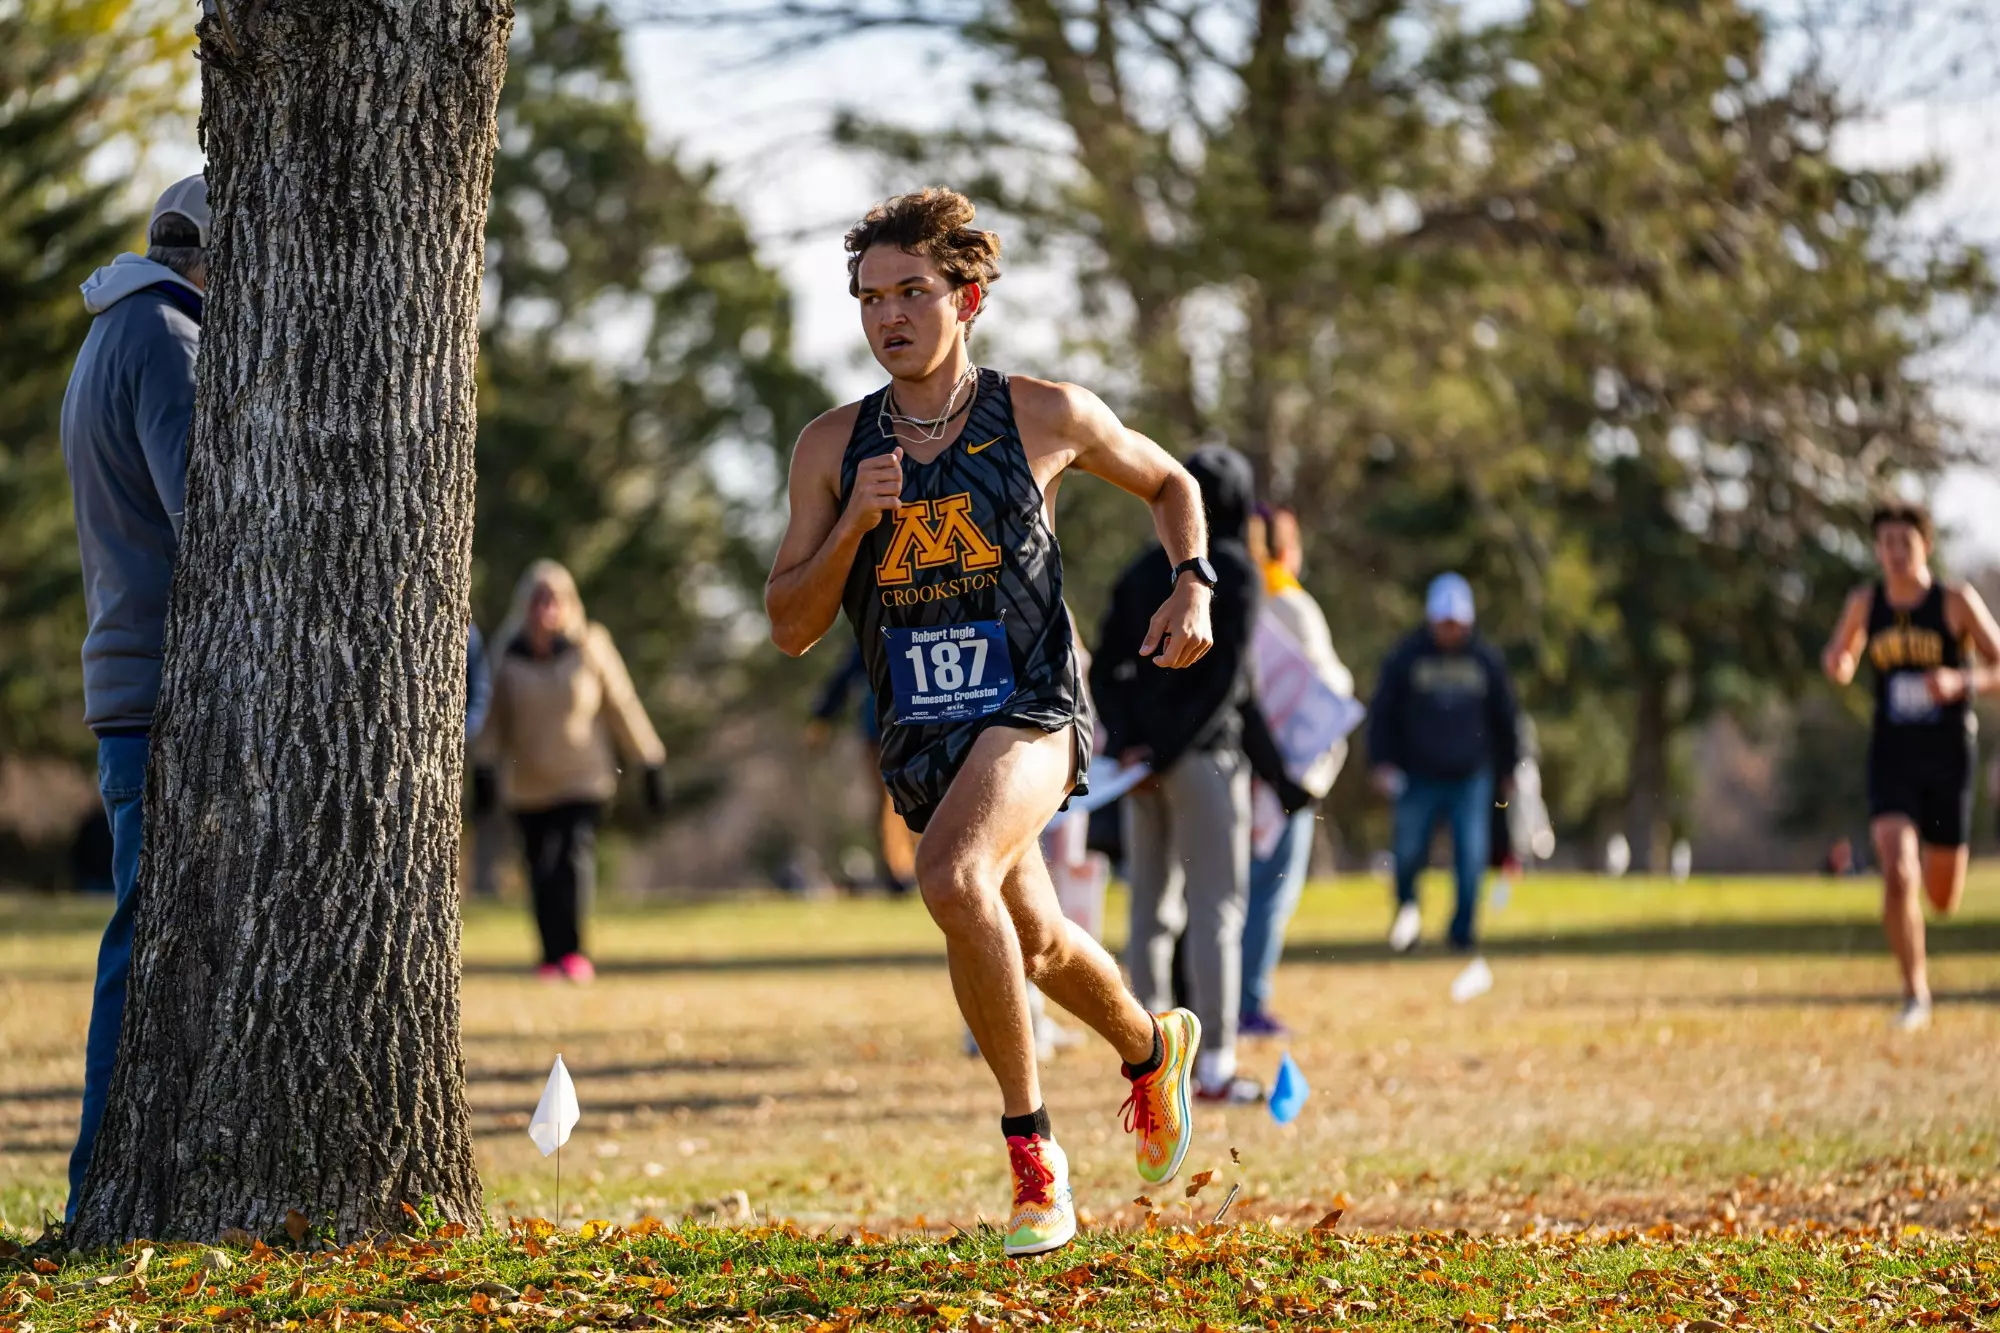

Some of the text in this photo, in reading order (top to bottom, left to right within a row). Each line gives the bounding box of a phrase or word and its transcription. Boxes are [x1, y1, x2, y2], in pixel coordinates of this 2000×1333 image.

[881, 570, 1000, 607] CROOKSTON
[912, 627, 975, 643] Robert Ingle
[905, 639, 988, 692] 187
[912, 688, 998, 704] Minnesota Crookston
